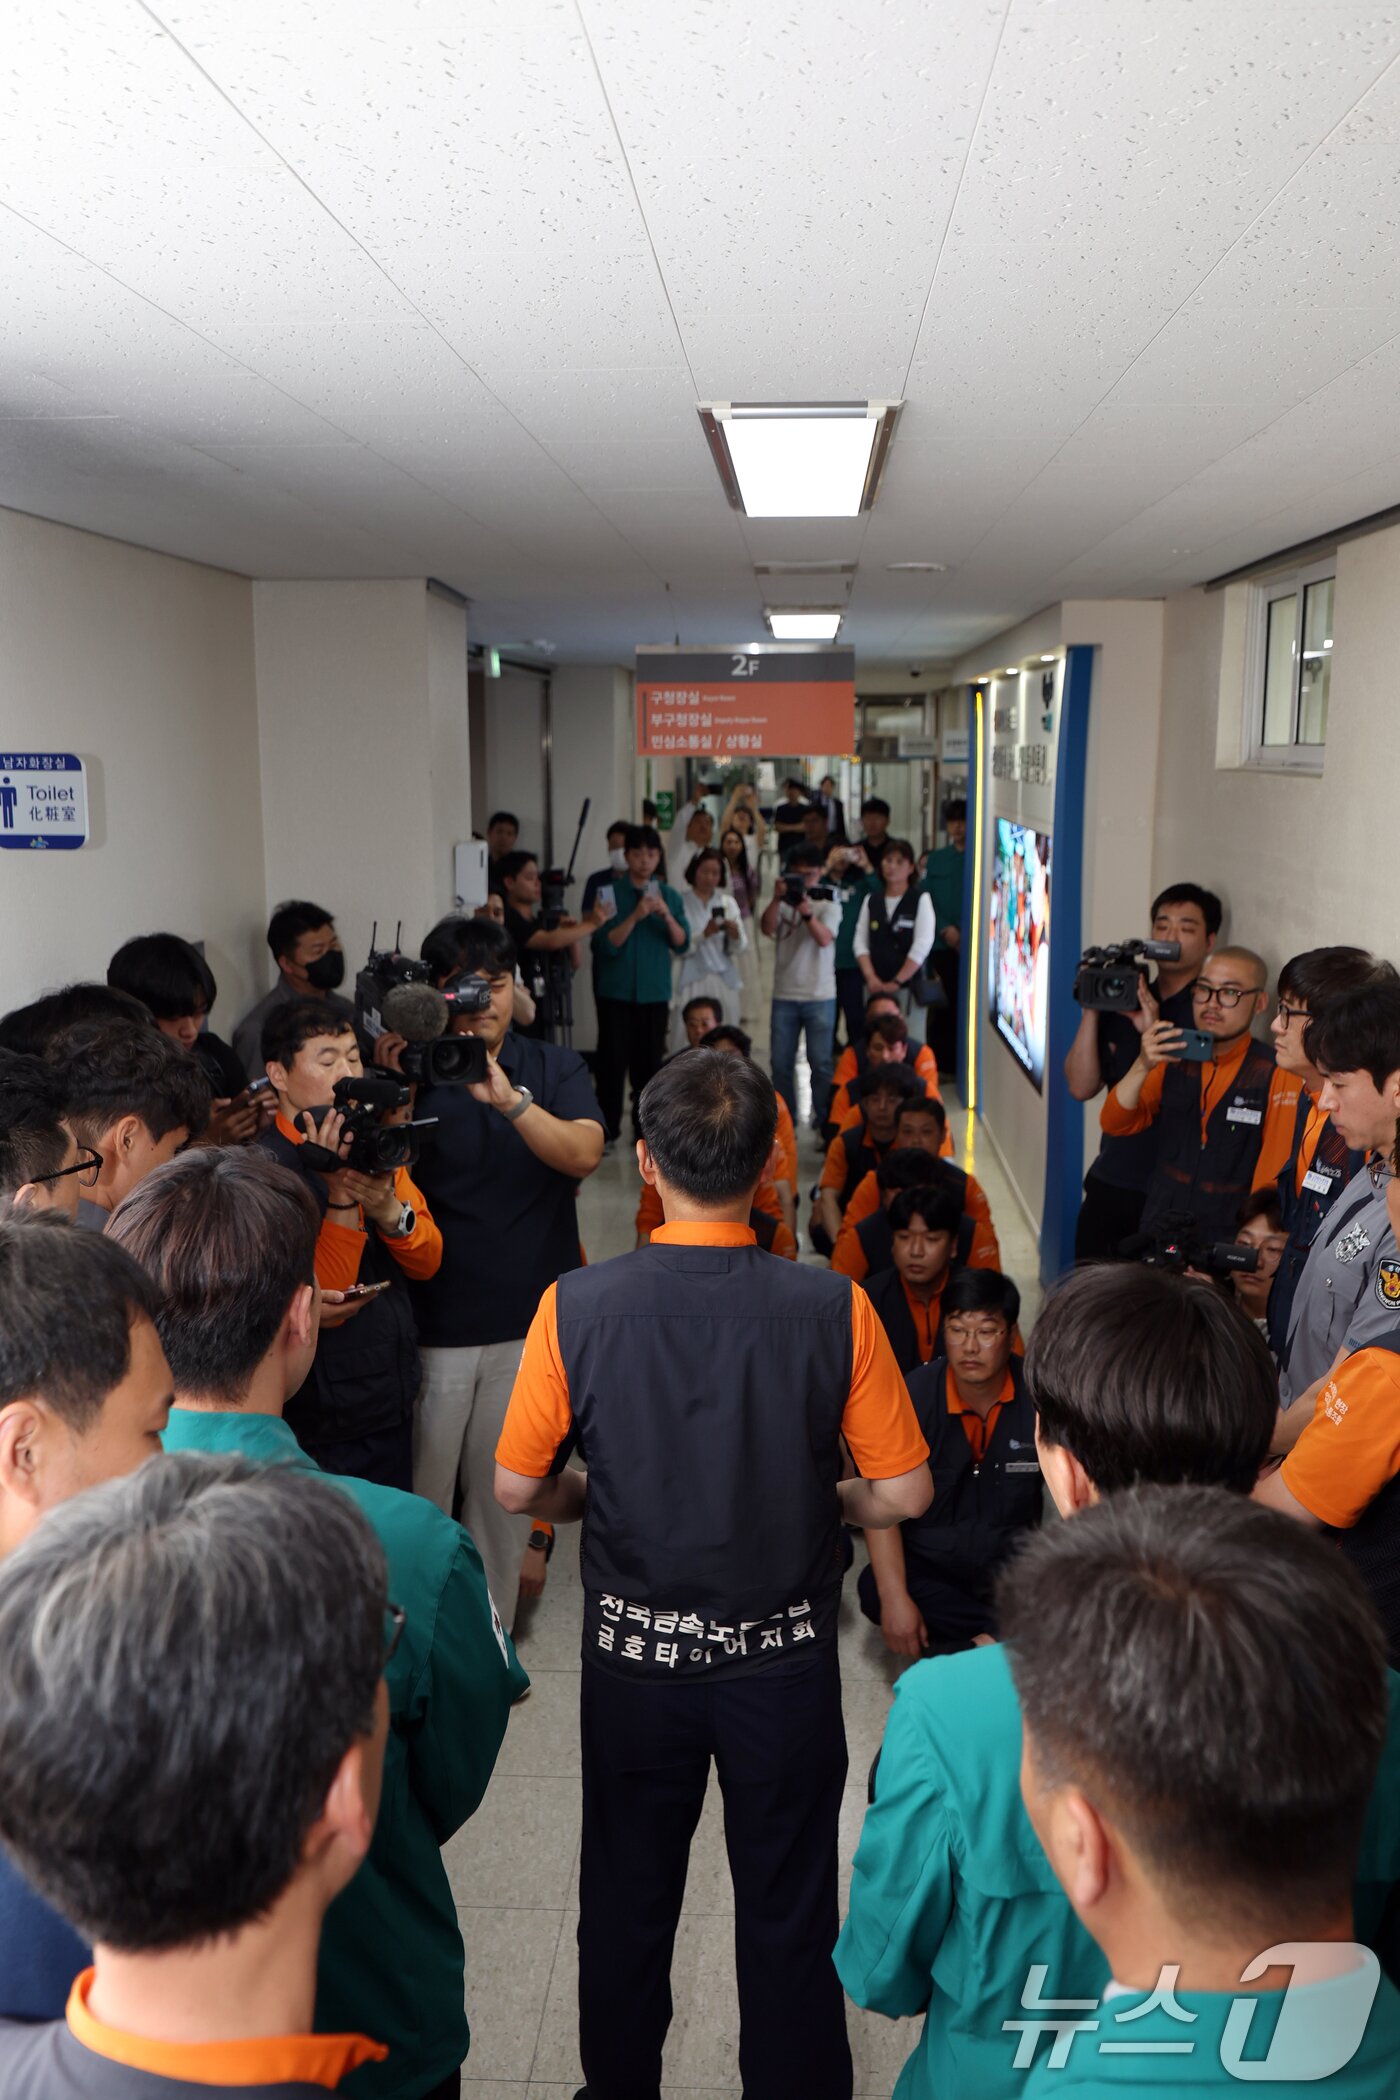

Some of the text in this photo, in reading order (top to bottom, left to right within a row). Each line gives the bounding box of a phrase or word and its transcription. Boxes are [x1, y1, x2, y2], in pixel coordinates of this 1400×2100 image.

[731, 654, 760, 676] 2F
[651, 690, 700, 705] 구청장실
[651, 712, 713, 727] 부구청장실
[651, 735, 713, 749] 민심소통실
[725, 735, 763, 749] 상황실
[2, 756, 66, 770] 남자화장실
[26, 785, 74, 801] Toilet
[599, 1592, 811, 1642] 전국금속노
